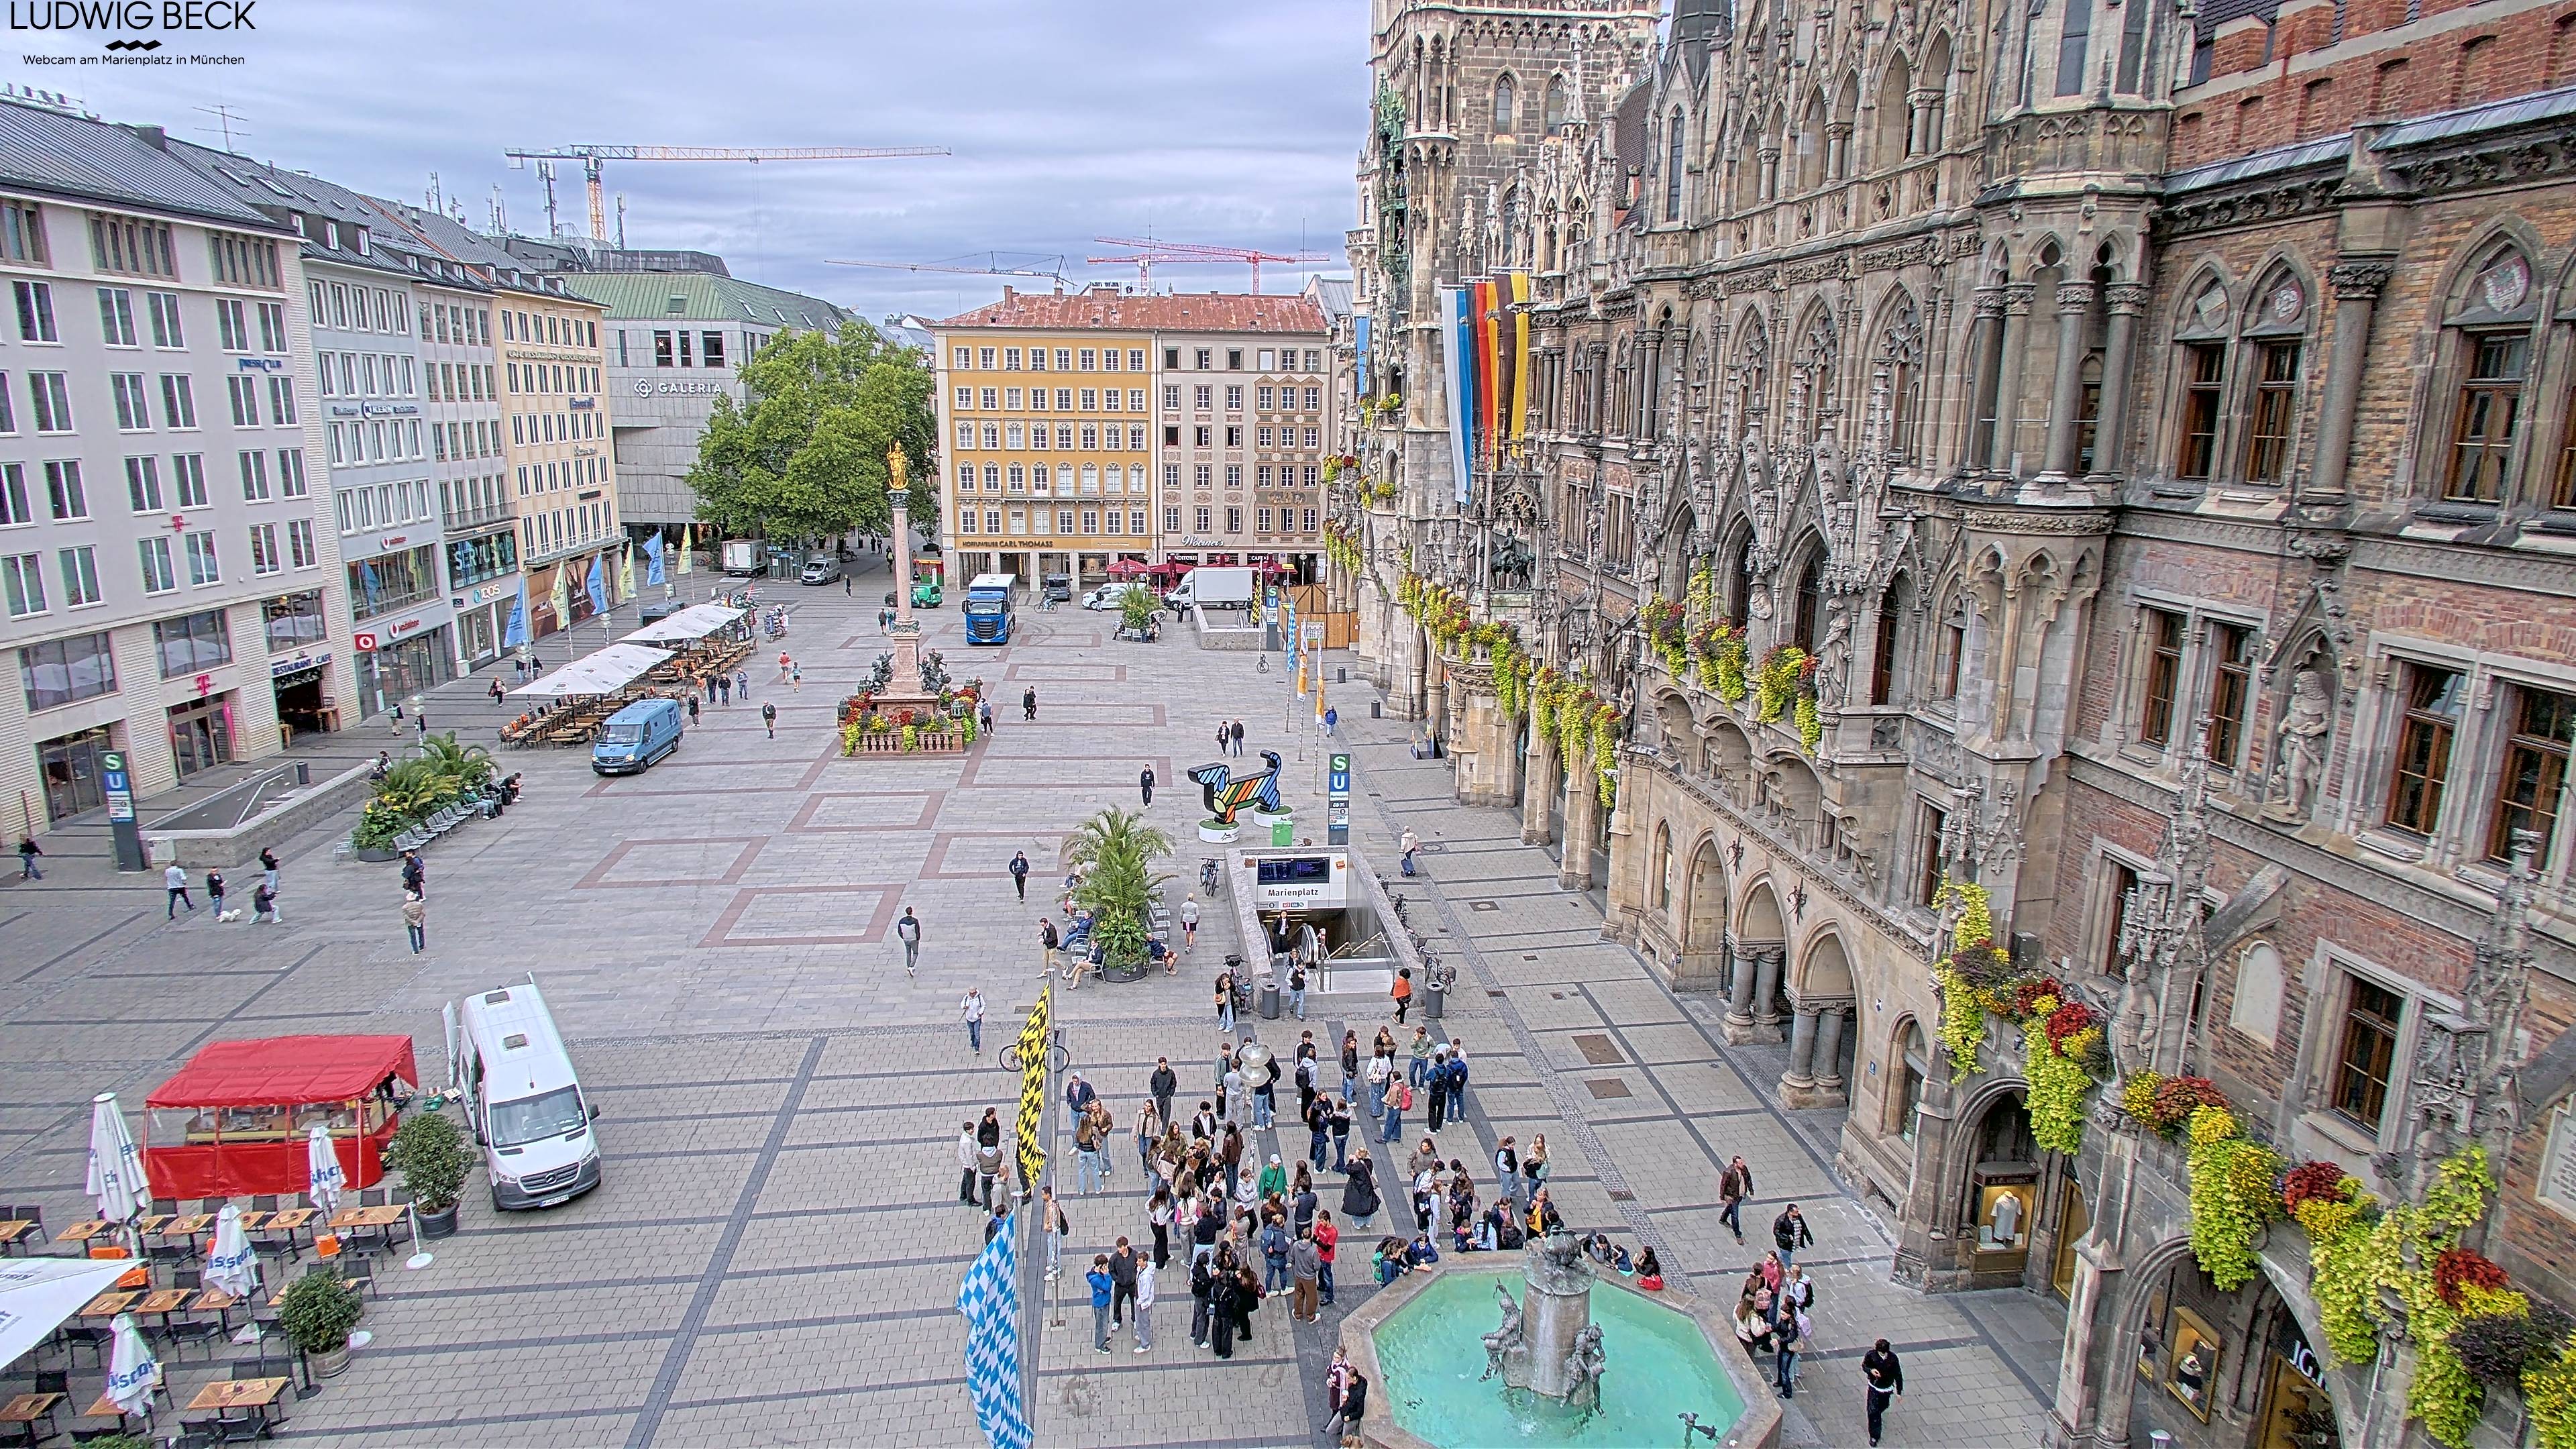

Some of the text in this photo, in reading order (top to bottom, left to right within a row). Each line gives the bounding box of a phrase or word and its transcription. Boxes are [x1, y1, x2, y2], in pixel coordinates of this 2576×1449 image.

[658, 382, 722, 393] GALERIA
[481, 584, 500, 599] IQOS
[1269, 588, 1277, 596] S
[1269, 599, 1276, 607] U
[105, 754, 121, 770] S
[1334, 755, 1346, 771] S
[107, 773, 123, 789] U
[1334, 775, 1345, 790] U
[1268, 888, 1319, 897] Marienplatz
